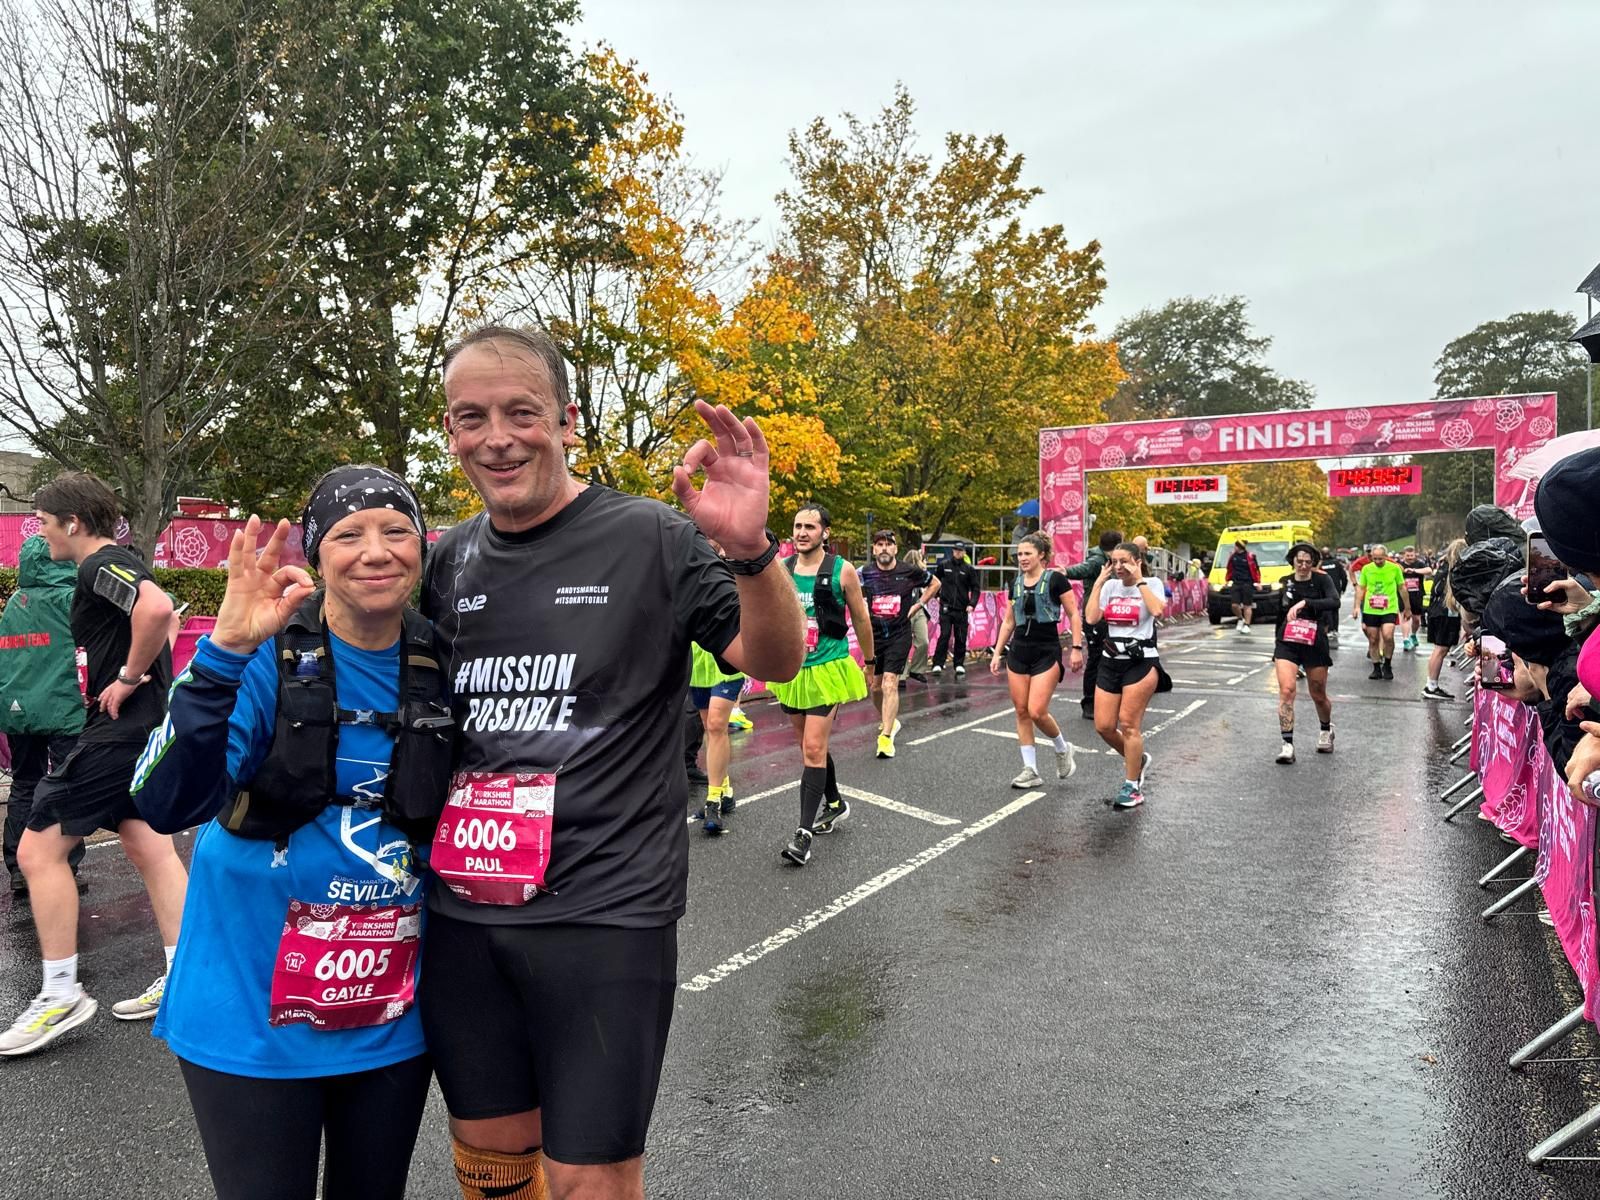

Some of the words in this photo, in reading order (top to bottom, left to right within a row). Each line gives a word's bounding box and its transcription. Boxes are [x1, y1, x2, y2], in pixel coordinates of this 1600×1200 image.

[1219, 420, 1332, 452] FINISH
[1350, 485, 1400, 494] MARATHON
[556, 586, 610, 594] #ANDYSMANCLUB
[554, 596, 608, 604] #ITSOKAYTOTALK
[1112, 606, 1131, 614] 9550
[28, 632, 50, 646] TEAM
[454, 654, 577, 694] #MISSION
[463, 696, 577, 732] POSSIBLE
[474, 798, 512, 806] MARATHON
[454, 818, 516, 851] 6006
[465, 857, 503, 872] PAUL
[328, 881, 400, 901] SEVILLA
[289, 958, 298, 968] XL
[314, 948, 392, 981] 6005
[322, 984, 374, 1001] GAYLE
